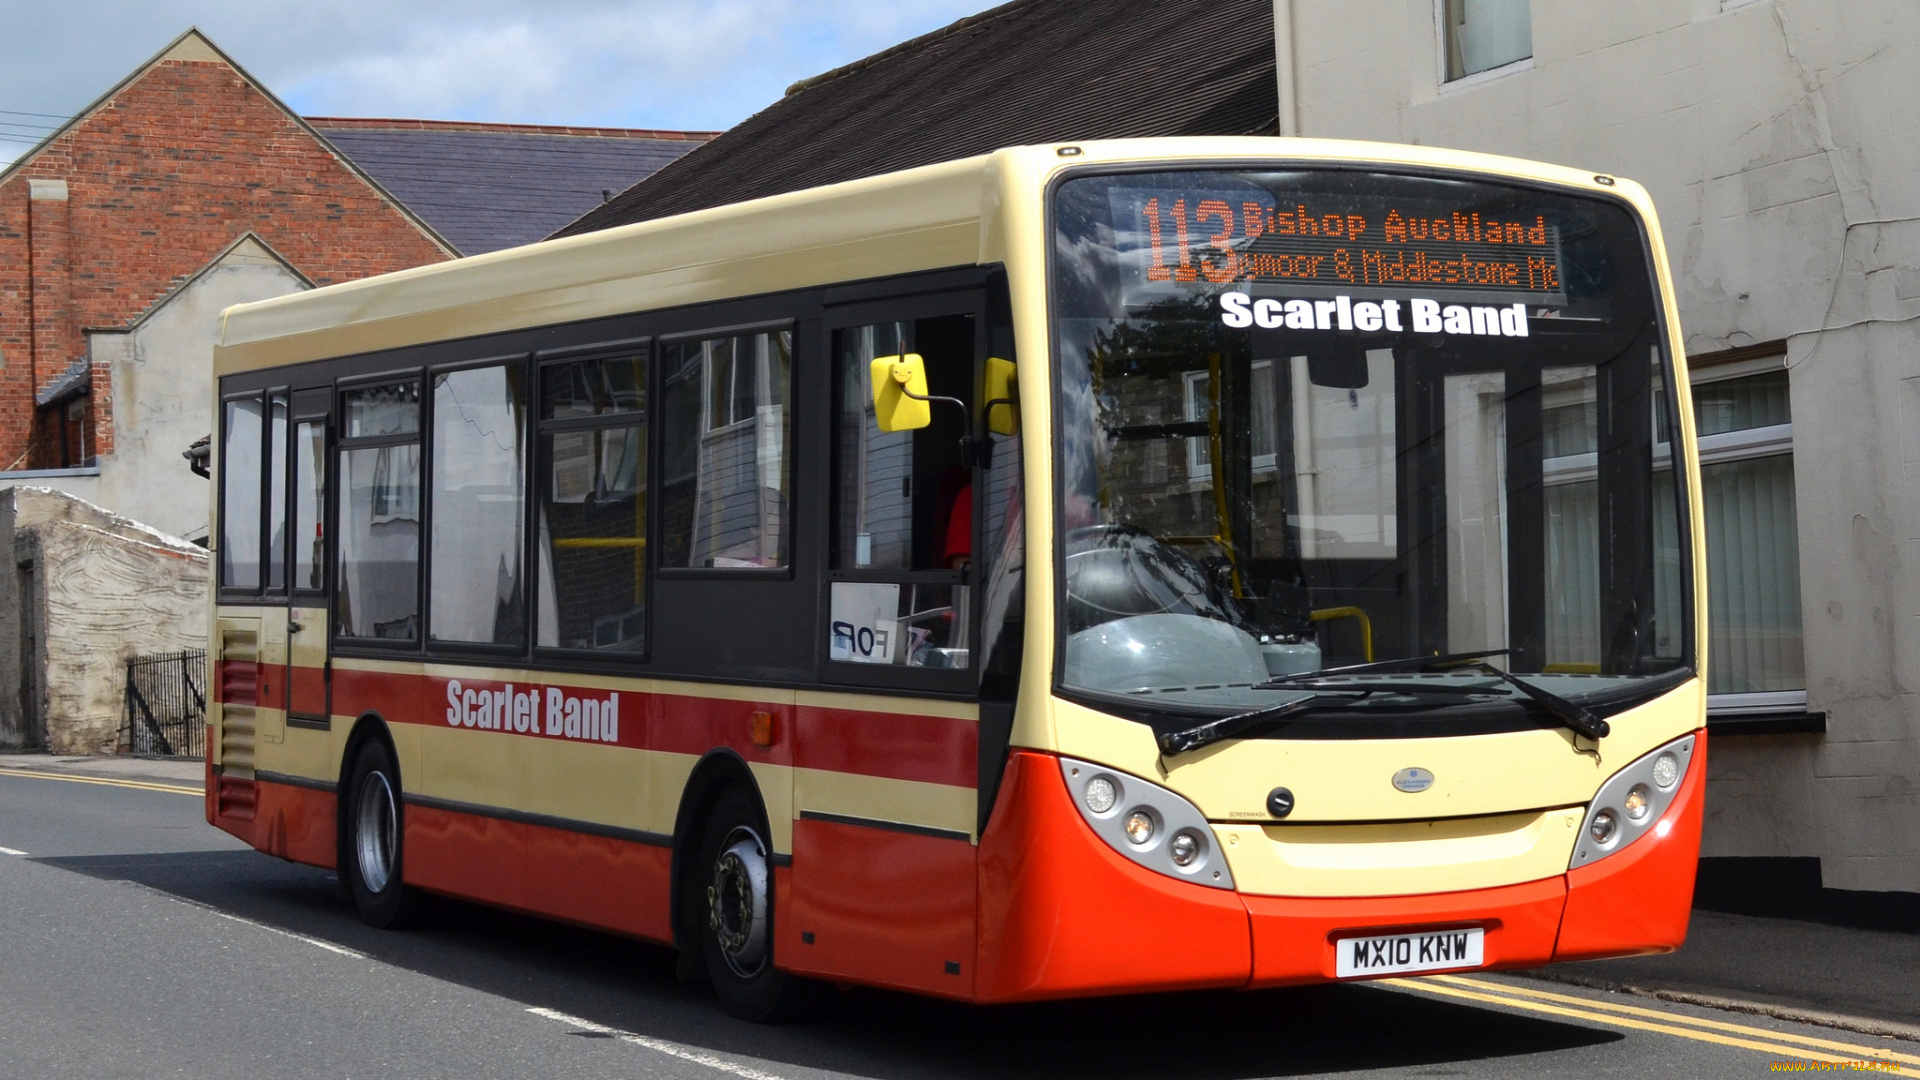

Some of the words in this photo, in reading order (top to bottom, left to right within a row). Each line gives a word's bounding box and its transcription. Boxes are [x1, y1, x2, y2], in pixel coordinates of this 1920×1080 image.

[1142, 198, 1238, 282] 113
[1243, 202, 1367, 240] Bishop
[1385, 209, 1547, 244] Auckland
[1334, 248, 1355, 283] &
[1362, 250, 1519, 285] Middlestone
[1219, 291, 1404, 331] Scarlet
[1410, 298, 1529, 337] Band
[446, 679, 540, 733] Scarlet
[546, 687, 619, 742] Band
[1353, 937, 1410, 968] MX10
[1419, 933, 1468, 963] KNW
